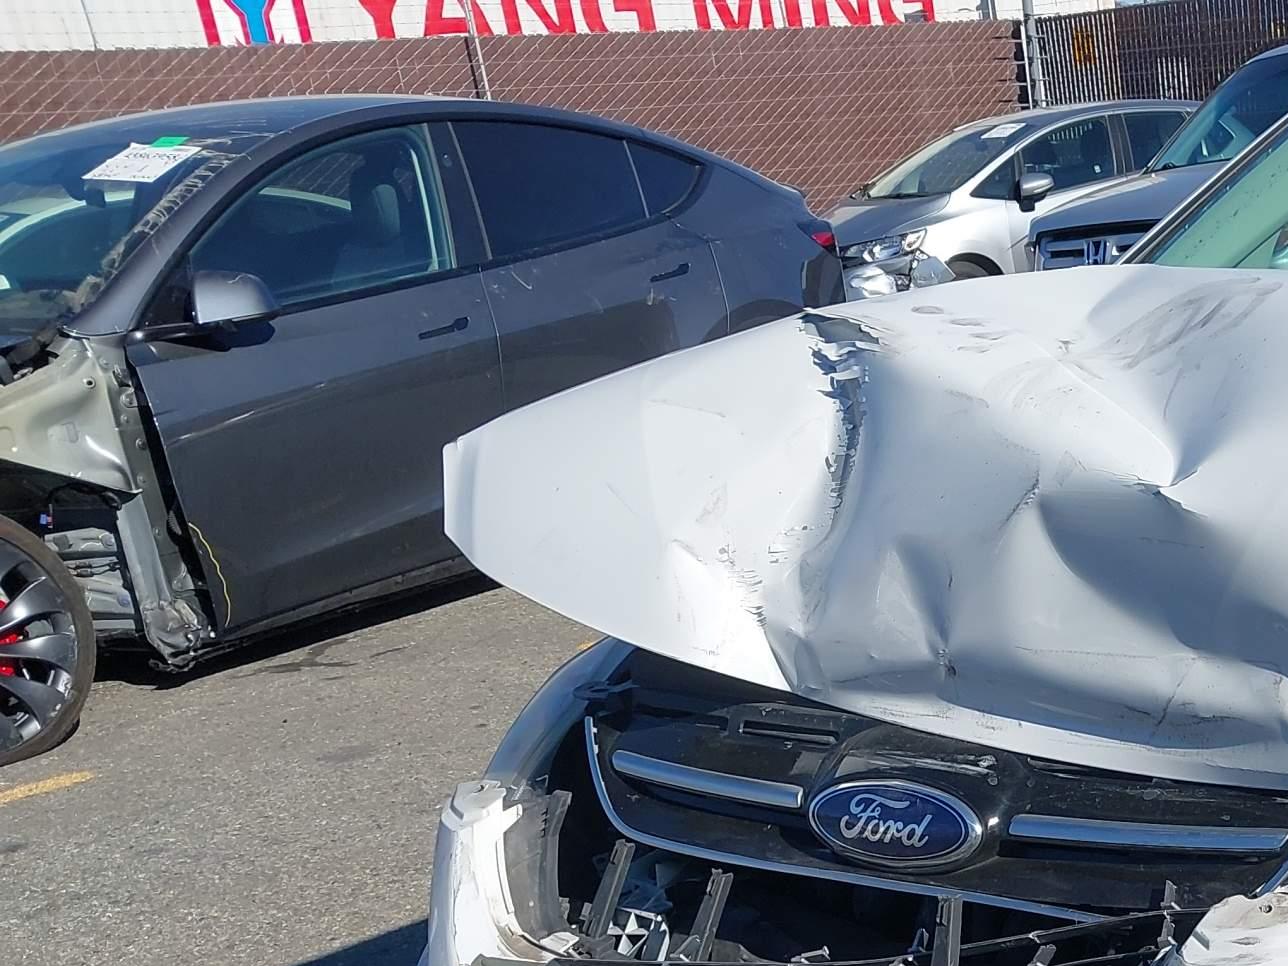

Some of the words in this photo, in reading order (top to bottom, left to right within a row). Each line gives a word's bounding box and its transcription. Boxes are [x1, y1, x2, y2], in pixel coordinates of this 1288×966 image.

[358, 0, 656, 39] YANG
[694, 0, 936, 31] MING
[840, 793, 933, 848] Ford
